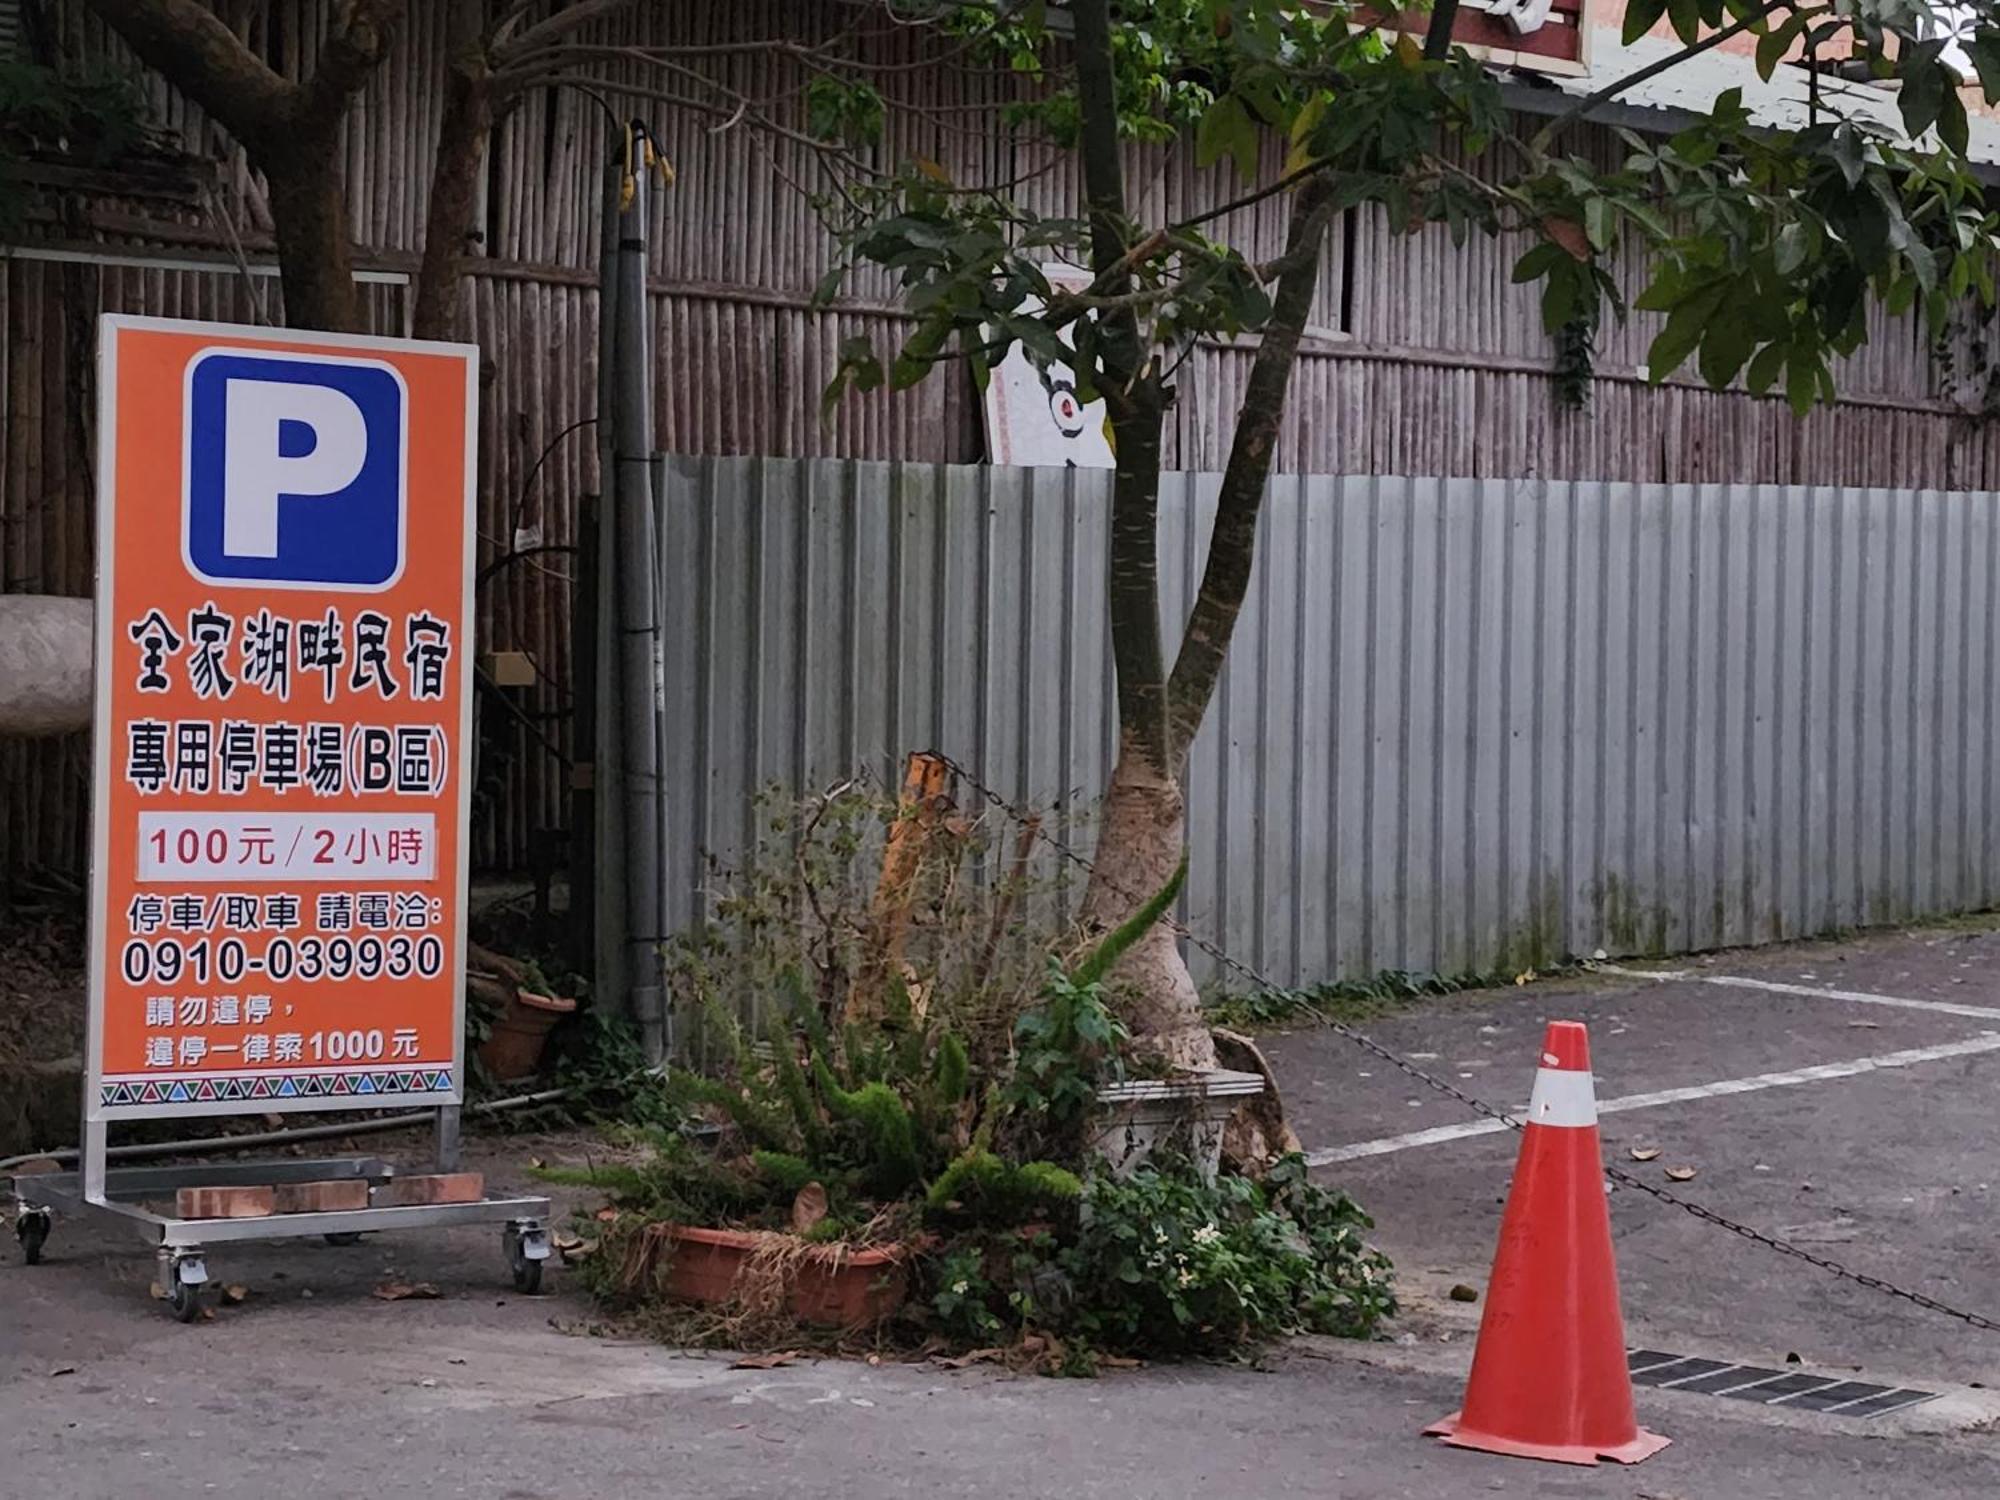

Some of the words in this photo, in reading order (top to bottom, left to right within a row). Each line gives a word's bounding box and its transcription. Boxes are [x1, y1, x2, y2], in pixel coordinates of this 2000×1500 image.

[224, 378, 367, 558] P
[129, 602, 452, 704] 全家湖畔民宿
[128, 720, 446, 796] 專用停車場(B區)
[128, 893, 301, 932] 停車/取車
[123, 936, 444, 984] 0910-039930
